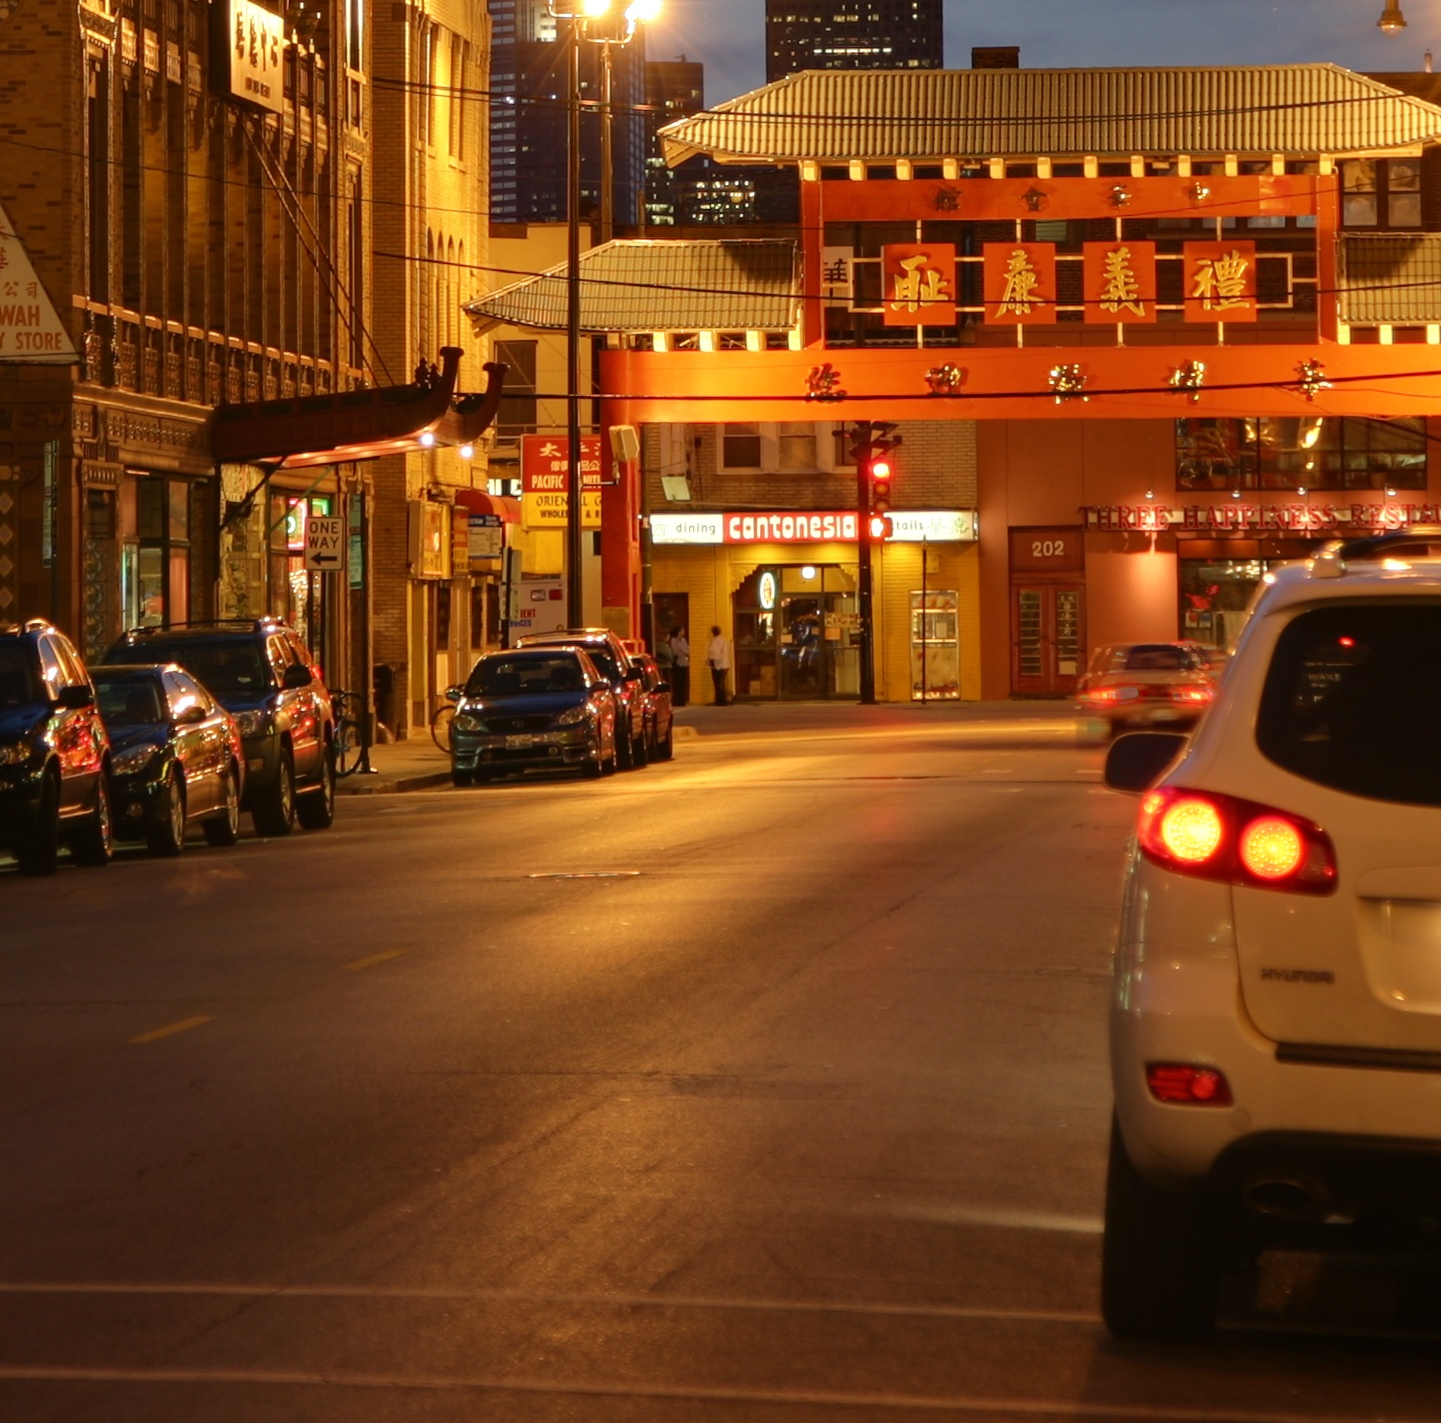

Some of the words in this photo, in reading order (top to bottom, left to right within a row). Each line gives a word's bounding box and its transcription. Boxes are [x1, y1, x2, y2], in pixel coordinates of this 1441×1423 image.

[16, 331, 62, 349] STORE
[531, 474, 564, 489] PACIFIC
[1079, 505, 1169, 530] THREE
[1182, 504, 1337, 530] HAPPINESS
[310, 521, 339, 535] ONE
[675, 522, 716, 535] dining
[729, 515, 855, 539] cantonesia
[309, 536, 339, 549] WAY
[1032, 540, 1064, 557] 202
